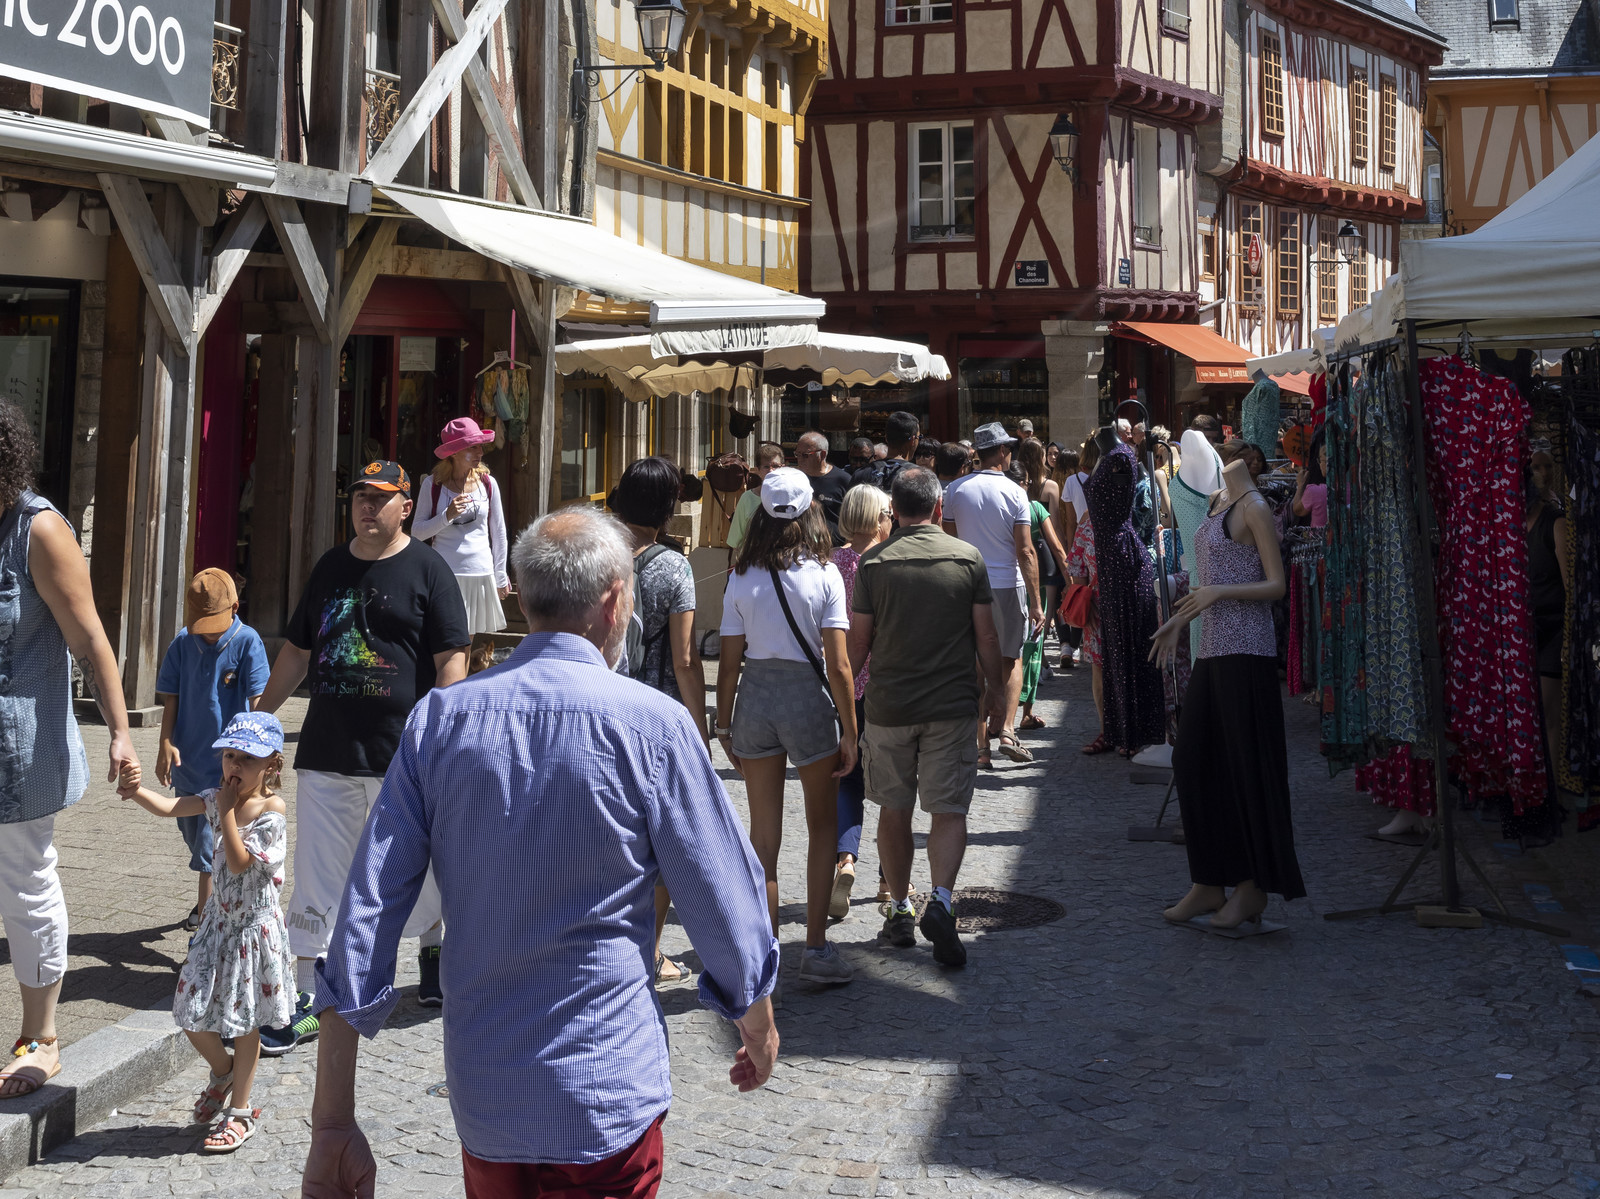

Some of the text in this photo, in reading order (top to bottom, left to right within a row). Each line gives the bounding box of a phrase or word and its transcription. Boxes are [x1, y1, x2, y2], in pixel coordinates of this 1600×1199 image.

[720, 322, 769, 349] LATITUDE
[338, 681, 359, 697] Saint
[361, 683, 391, 697] Michel
[288, 912, 320, 934] PUMA
